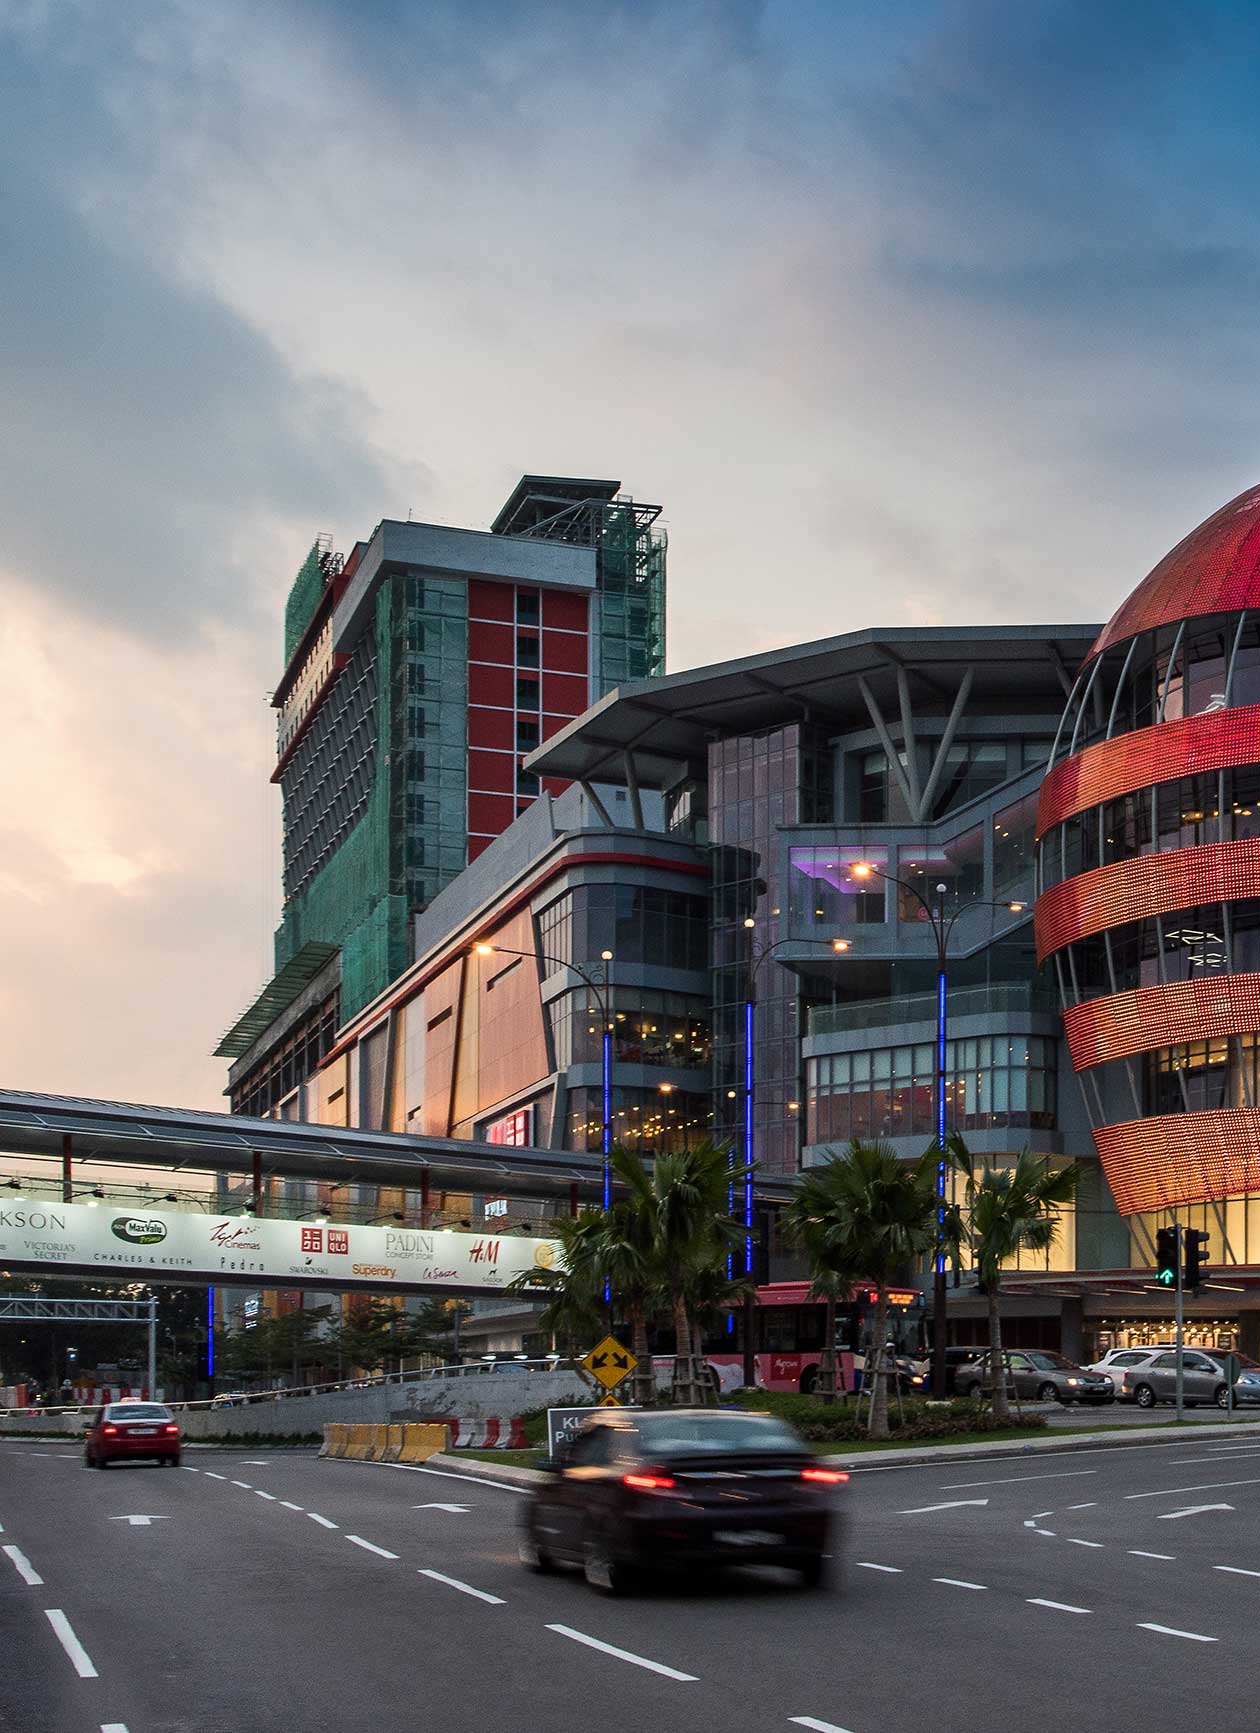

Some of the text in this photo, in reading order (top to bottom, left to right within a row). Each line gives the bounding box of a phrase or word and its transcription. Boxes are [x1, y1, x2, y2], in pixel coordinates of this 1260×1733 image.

[329, 1232, 346, 1242] UNI
[225, 1240, 260, 1250] Cinemas
[329, 1242, 347, 1253] QLO
[386, 1233, 434, 1254] PADINI
[33, 1250, 68, 1260] SECRET
[469, 1239, 501, 1265] H&M
[94, 1253, 193, 1265] CHARLES & KEITH
[220, 1257, 264, 1271] Pedro
[352, 1263, 397, 1279] Superdry
